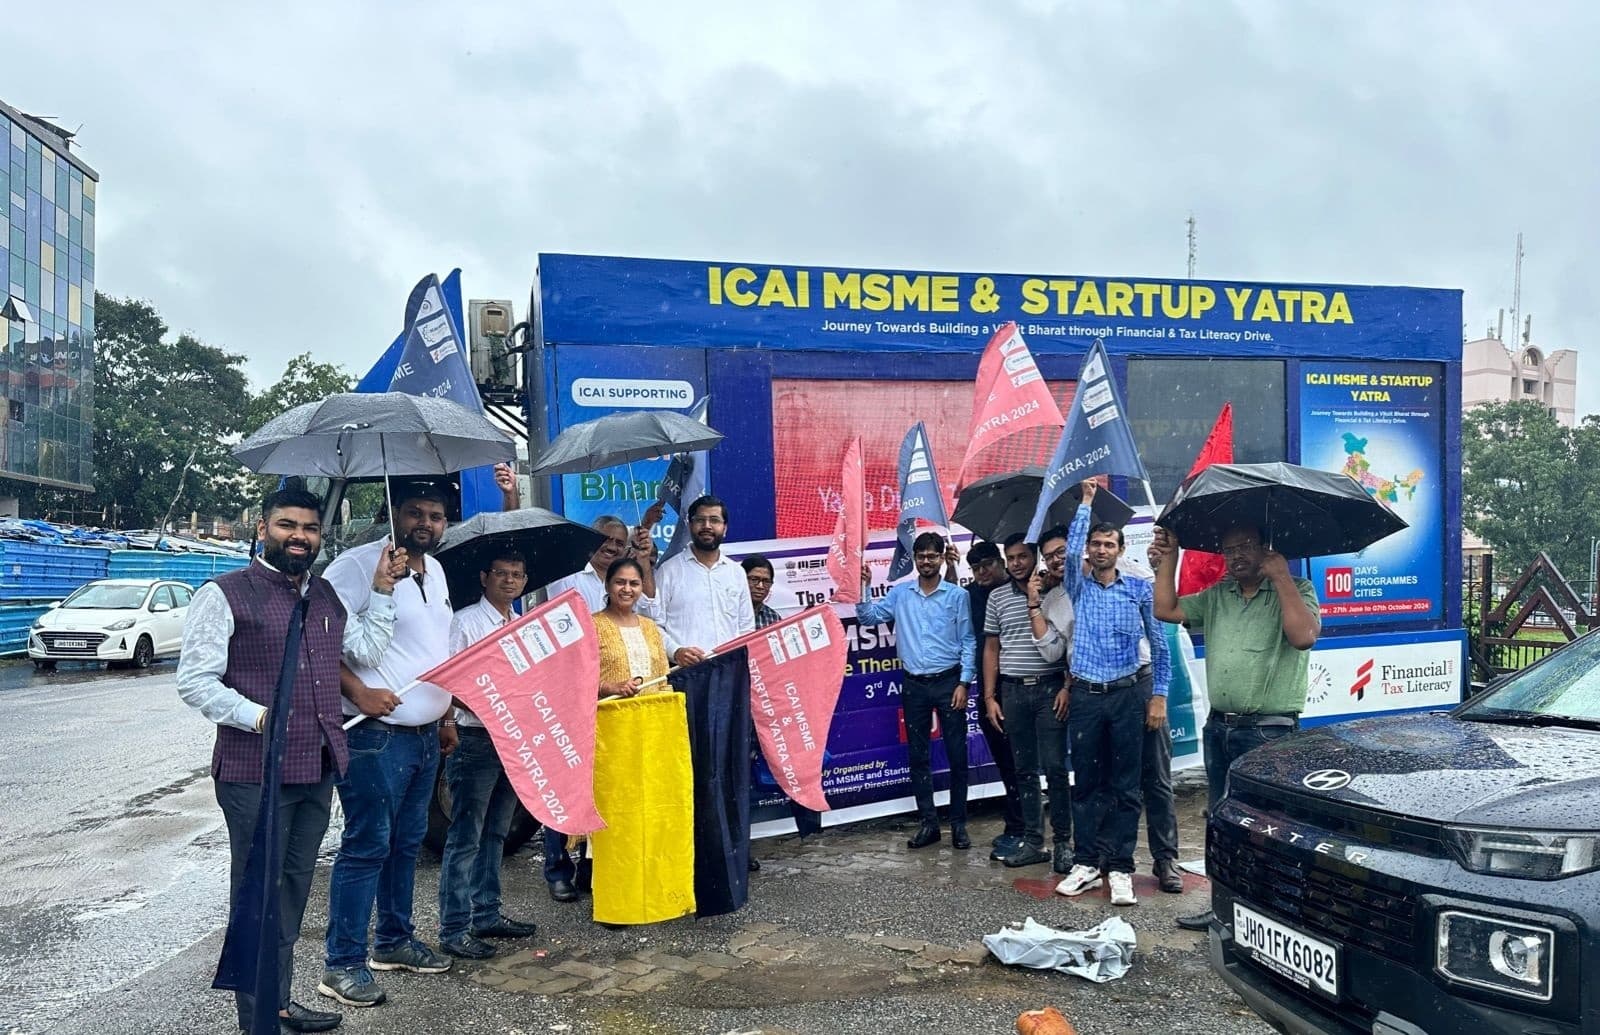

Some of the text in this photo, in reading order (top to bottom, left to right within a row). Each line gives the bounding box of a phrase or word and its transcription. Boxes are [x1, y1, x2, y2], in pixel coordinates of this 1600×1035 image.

[708, 266, 1354, 324] ICAI MSME & STARTUP YATRA
[821, 320, 872, 335] Journey
[875, 321, 926, 334] Towards
[929, 322, 979, 336] Building
[982, 325, 989, 334] a
[1028, 324, 1066, 335] Bharat
[1069, 325, 1113, 339] through
[1117, 326, 1166, 338] Financial
[1168, 328, 1176, 338] &
[1179, 329, 1196, 339] Tax
[1200, 329, 1241, 342] Literacy
[1244, 331, 1274, 342] Drive.
[1306, 373, 1432, 387] ICAI MSME & STARTUP
[579, 387, 688, 399] ICAI SUPPORTING
[1350, 390, 1391, 401] YATRA
[1010, 399, 1040, 420] 2024
[1085, 444, 1111, 465] 2024
[903, 496, 925, 511] 2024
[1354, 566, 1378, 575] DAYS
[1326, 572, 1351, 593] 100
[1354, 576, 1418, 587] PROGRAMMES
[1354, 588, 1383, 598] CITIES
[1381, 660, 1447, 681] Financial
[1381, 680, 1452, 695] Tax Literacy
[748, 657, 802, 794] STARTUP YATRA 2024
[781, 715, 793, 727] &
[784, 682, 816, 752] ICAI MSME
[531, 690, 582, 769] ICAI MSME
[1170, 727, 1185, 739] CAI
[475, 673, 522, 741] STARTUP
[516, 741, 550, 791] YATRA
[542, 789, 569, 825] 2024
[532, 733, 546, 748] &
[833, 763, 874, 776] Organised
[875, 759, 888, 770] by:
[823, 767, 910, 787] on MSME and Startu
[827, 784, 863, 796] Literacy
[1239, 816, 1369, 866] EXTER
[1243, 916, 1335, 985] JH01FK6082
